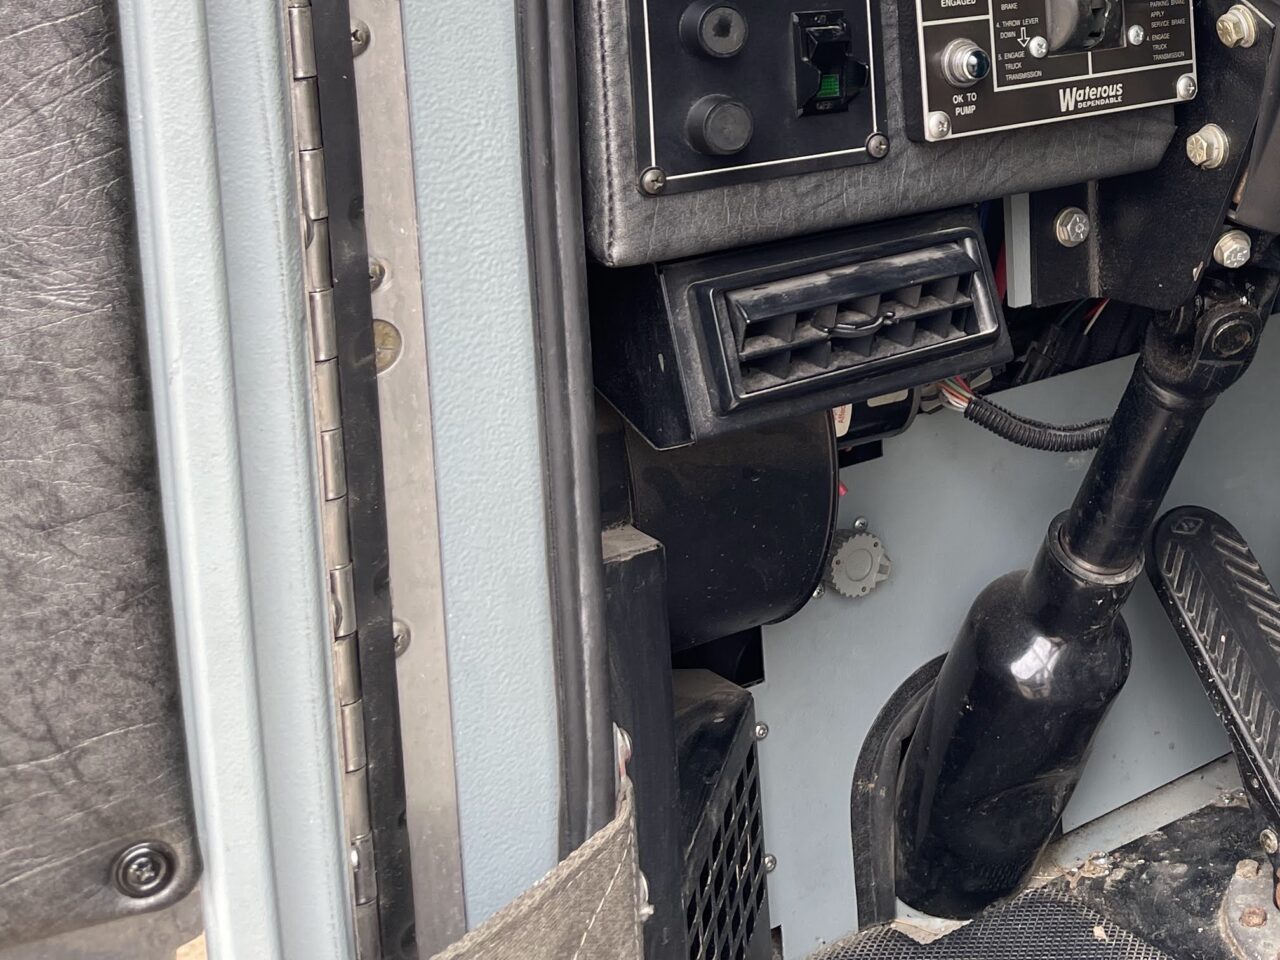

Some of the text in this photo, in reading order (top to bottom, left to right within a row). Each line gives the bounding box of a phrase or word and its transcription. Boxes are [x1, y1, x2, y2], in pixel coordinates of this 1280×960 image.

[1005, 51, 1024, 59] ENGAGE
[1153, 51, 1184, 60] TRANSMISSION
[1005, 62, 1022, 70] TRUCK
[1005, 71, 1042, 81] TRANSMISSION
[953, 94, 963, 104] OK
[1059, 83, 1123, 112] Waterous
[1077, 95, 1123, 109] DEPENDABLE
[956, 105, 975, 115] PUMP
